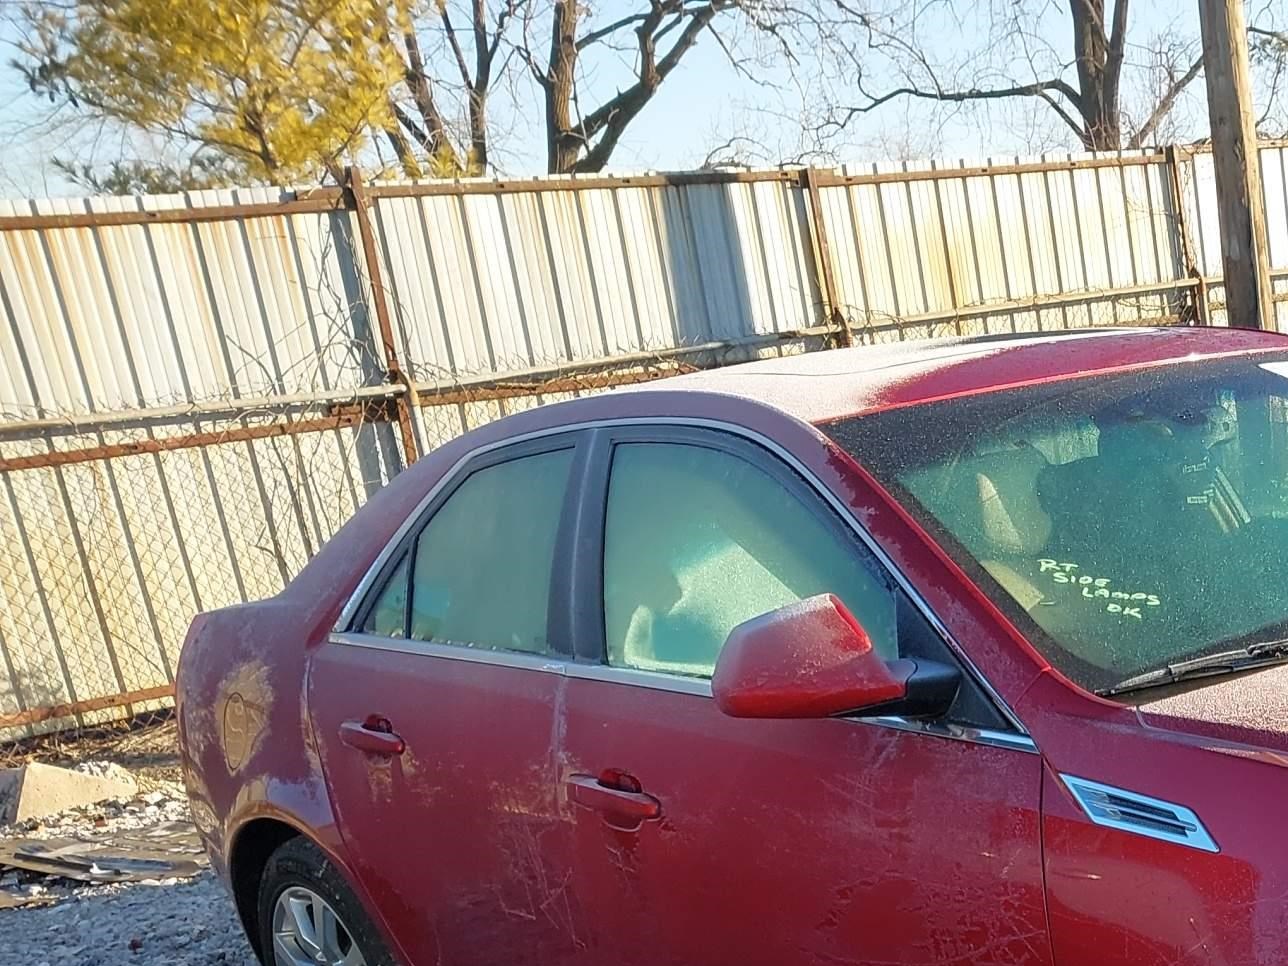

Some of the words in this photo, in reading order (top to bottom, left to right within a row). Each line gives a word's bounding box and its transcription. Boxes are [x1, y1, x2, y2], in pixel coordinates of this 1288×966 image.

[1037, 558, 1079, 572] RT
[1053, 572, 1111, 588] SIDE
[1106, 603, 1142, 619] OK
